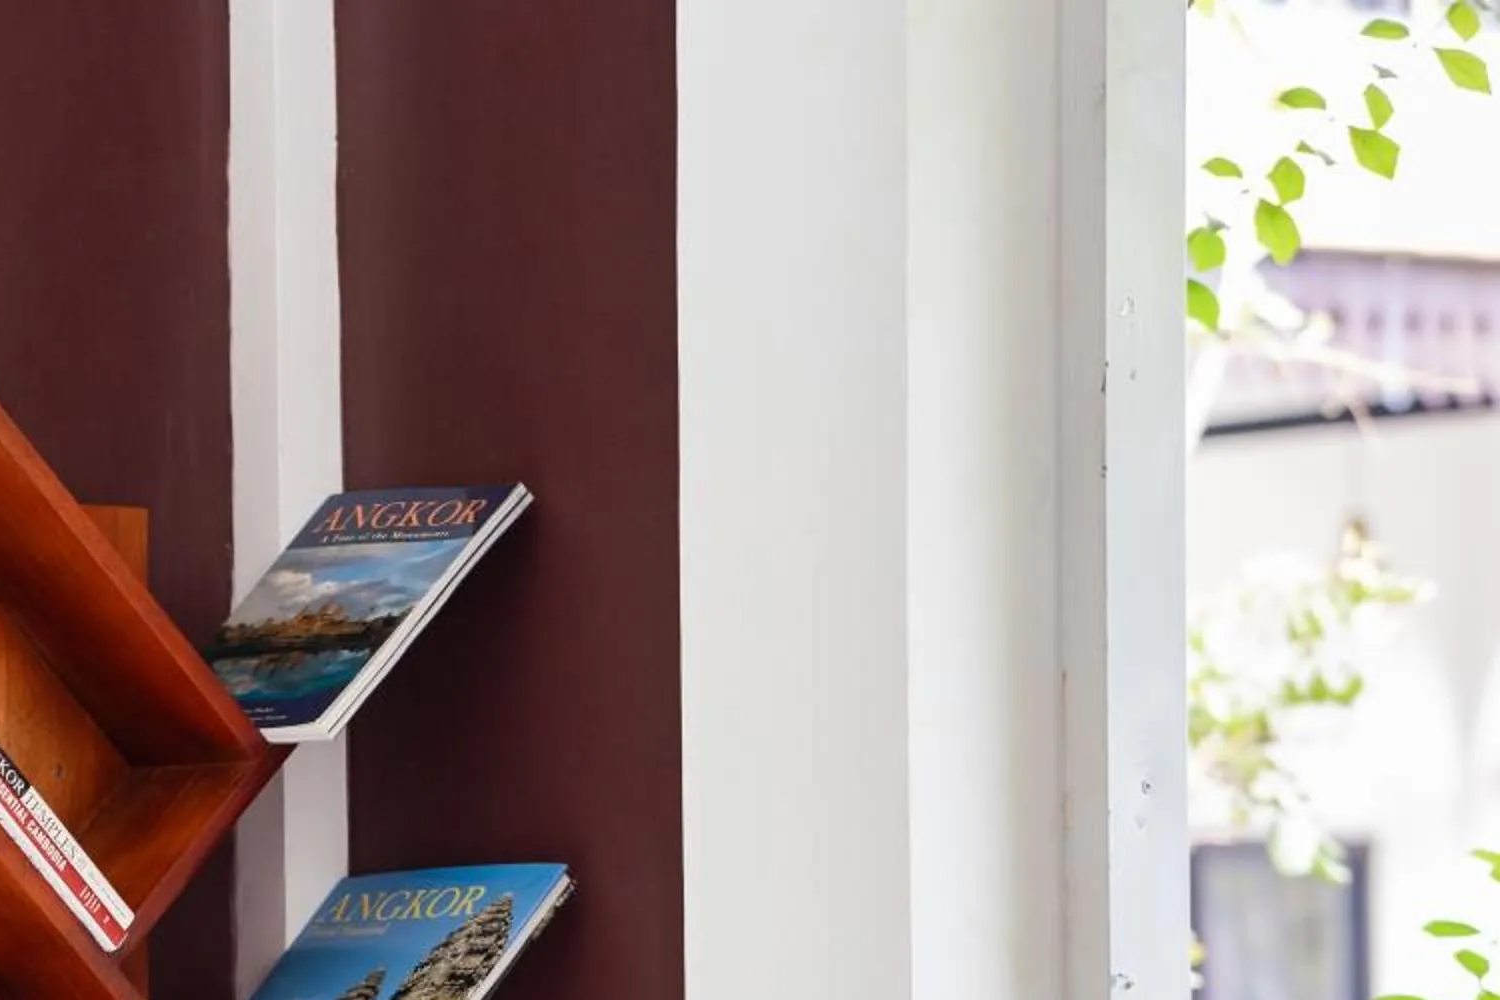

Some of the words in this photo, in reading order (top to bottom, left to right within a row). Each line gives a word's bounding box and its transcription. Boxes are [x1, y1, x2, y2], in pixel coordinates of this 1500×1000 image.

[312, 499, 487, 532] ANGKOR
[23, 790, 79, 860] TEMPLES
[26, 819, 67, 872] CAMBODIA
[315, 885, 486, 922] ANGKOR
